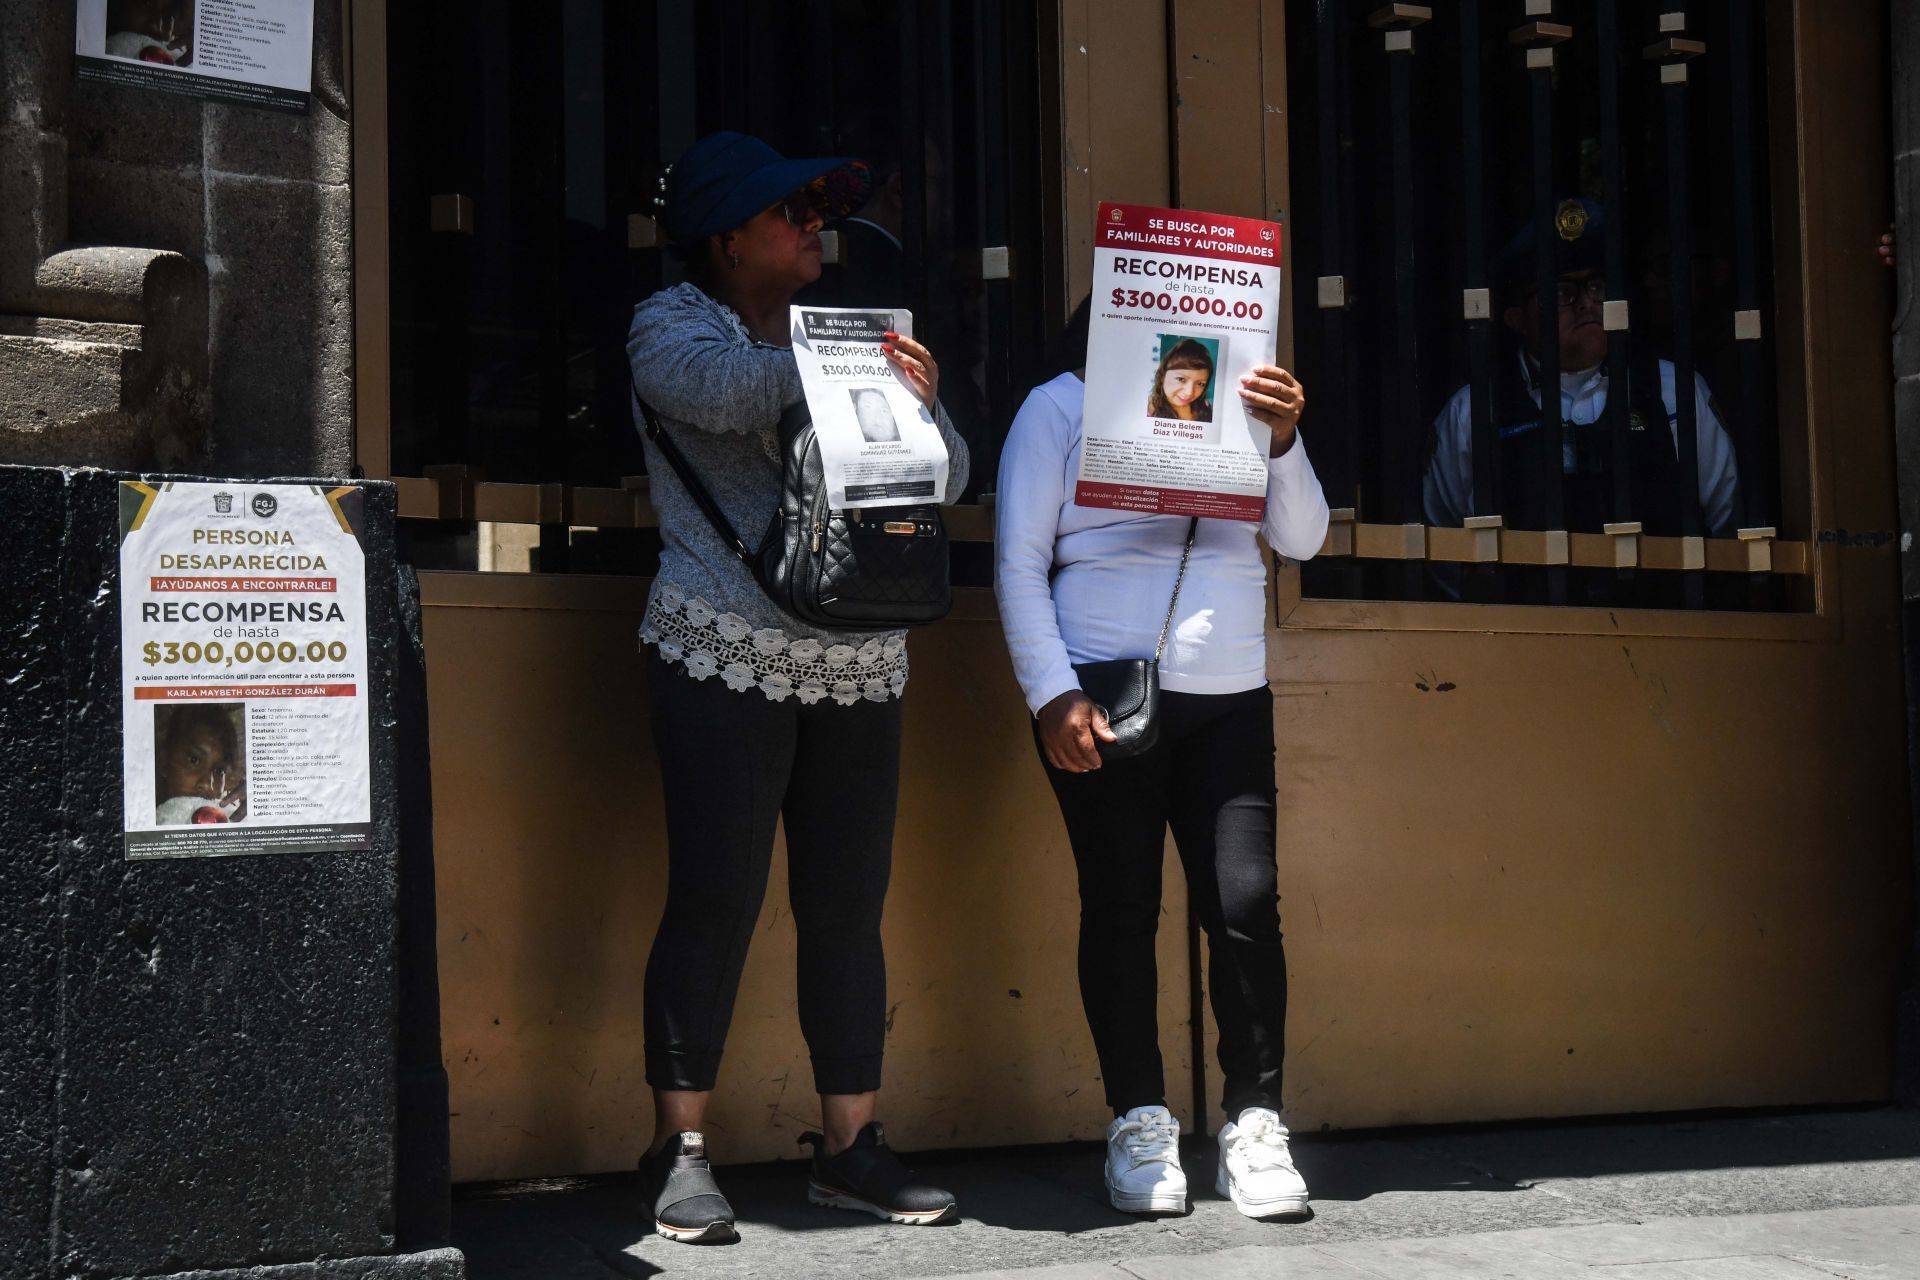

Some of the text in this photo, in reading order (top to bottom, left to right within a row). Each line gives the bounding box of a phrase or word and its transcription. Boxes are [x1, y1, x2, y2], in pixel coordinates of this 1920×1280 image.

[1149, 219, 1235, 237] SE BUSCA POR
[1107, 230, 1274, 257] FAMILIARES Y AUTORIDADES
[1114, 257, 1263, 288] RECOMPENSA
[1165, 281, 1214, 295] de hasta
[1111, 288, 1262, 320] $300,000.00
[822, 364, 891, 377] $300,000.00
[1155, 421, 1202, 431] Diana Belem
[1173, 430, 1203, 439] Villegas
[193, 529, 294, 545] PERSONA
[160, 555, 327, 570] DESAPARECIDA
[156, 578, 331, 590] ¡AYÚDANOS A ENCONTRARLE!
[142, 602, 345, 622] RECOMPENSA
[213, 626, 279, 638] de hasta
[143, 641, 347, 668] $300,000.00
[167, 686, 325, 697] KARLA MAYBETH GONZÁLEZ DURÁN
